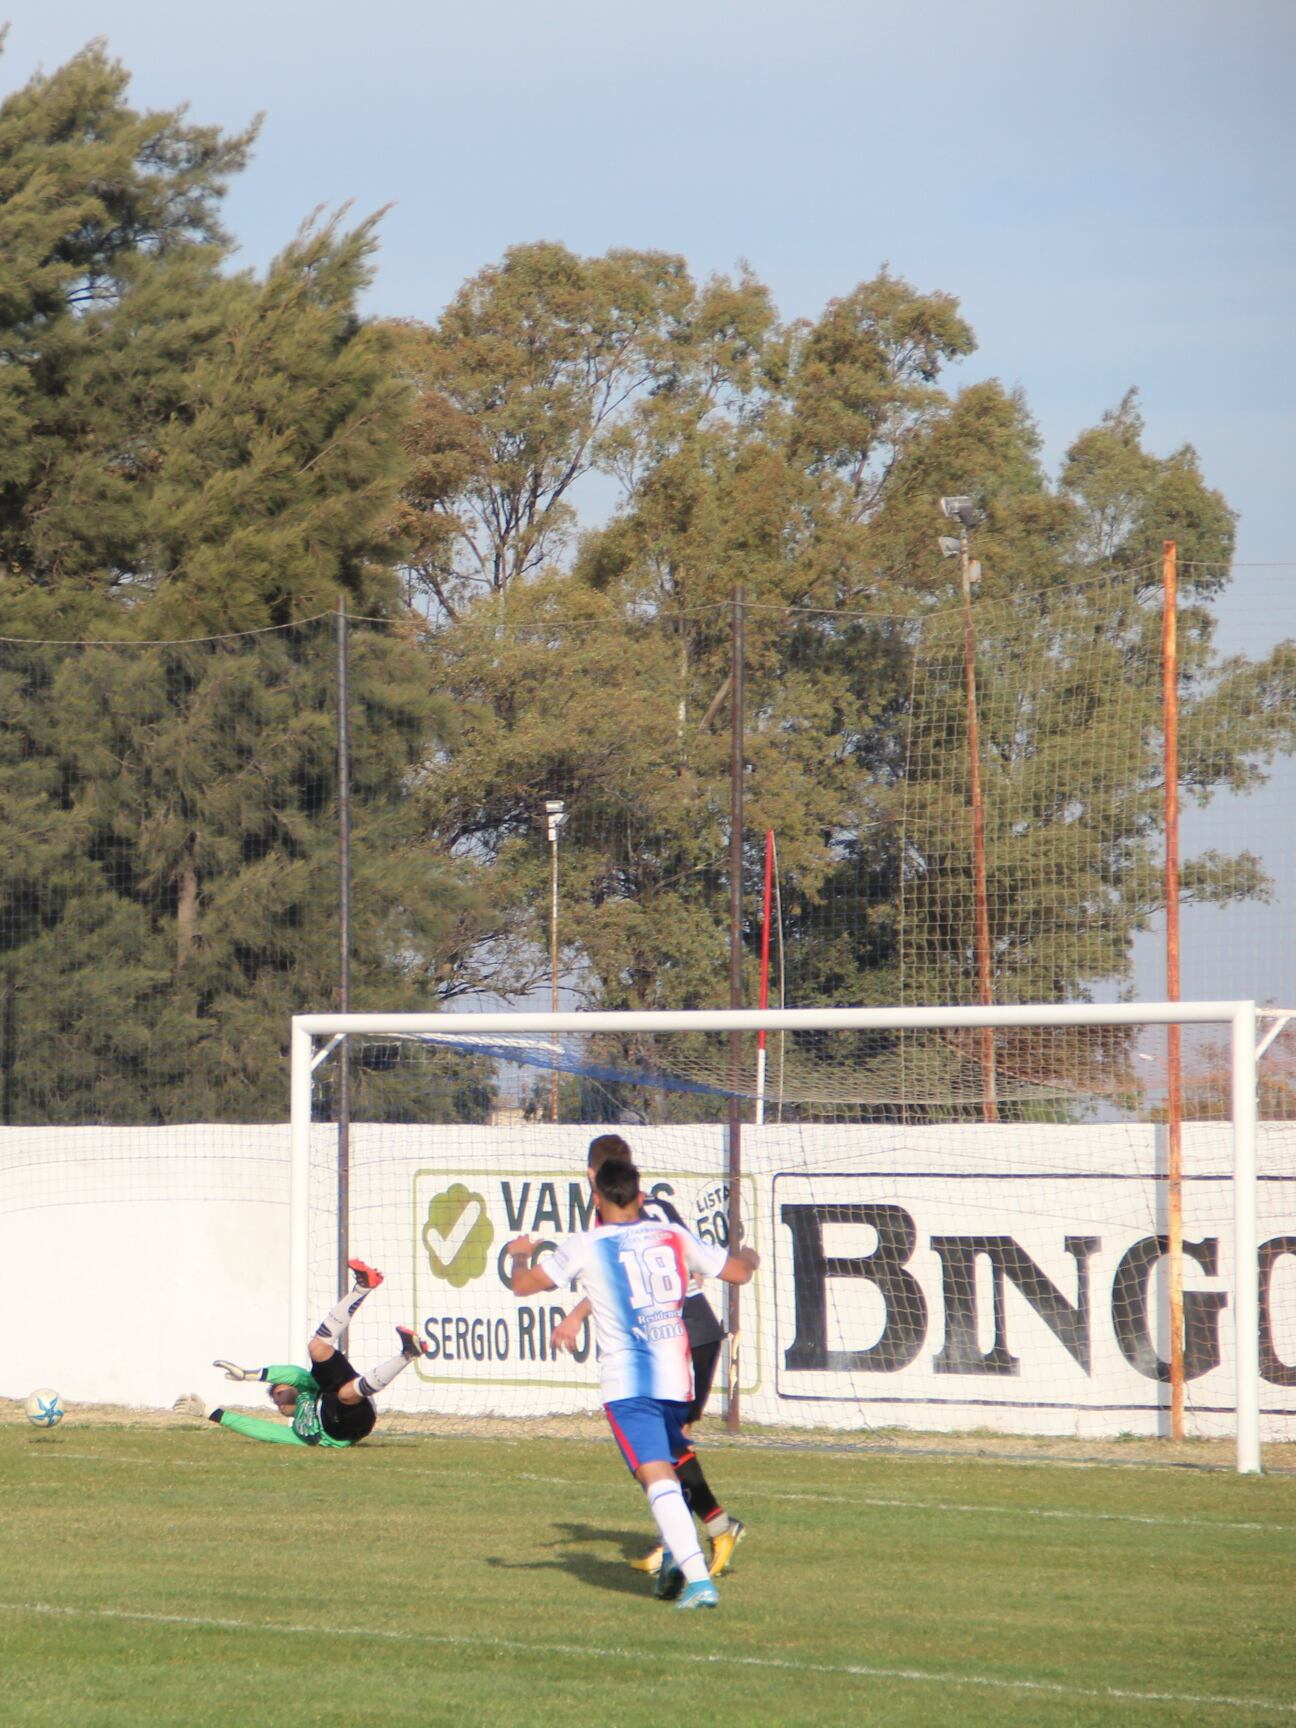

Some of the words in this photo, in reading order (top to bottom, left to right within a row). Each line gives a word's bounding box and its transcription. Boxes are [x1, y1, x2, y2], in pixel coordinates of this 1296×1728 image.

[501, 1181, 675, 1233] VAM
[697, 1211, 731, 1248] 50
[619, 1245, 682, 1310] 18
[424, 1316, 509, 1362] SERGIO
[518, 1306, 601, 1363] RIPO
[637, 1310, 682, 1324] Residenc
